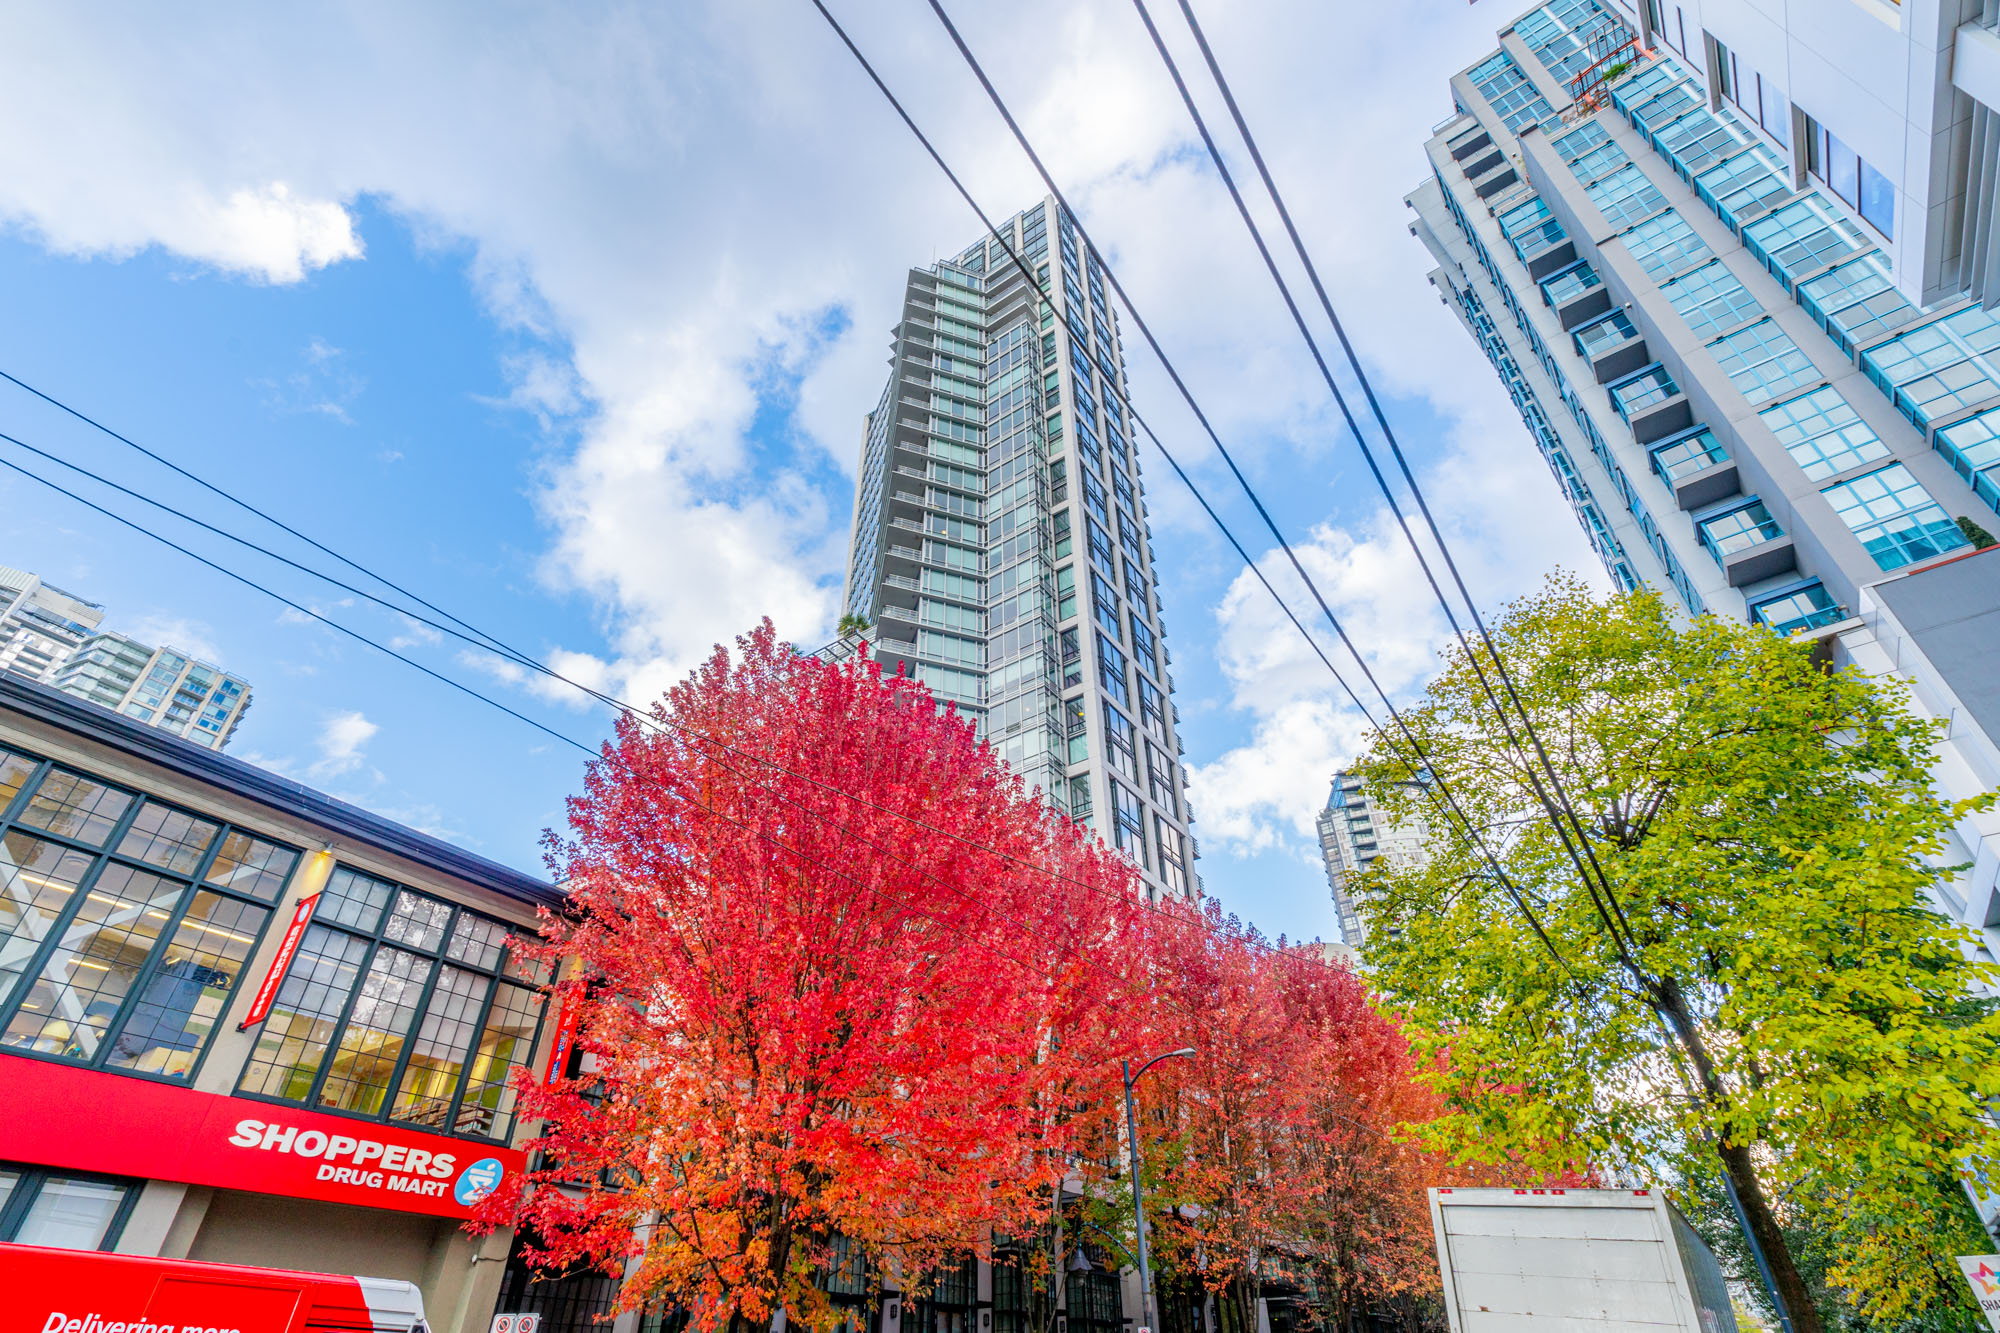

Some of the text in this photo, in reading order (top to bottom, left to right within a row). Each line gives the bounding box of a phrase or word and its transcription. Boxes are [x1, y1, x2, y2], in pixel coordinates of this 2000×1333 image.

[228, 1119, 457, 1179] SHOPPERS
[316, 1164, 450, 1197] DRUG MART
[1981, 1299, 2000, 1311] SHA
